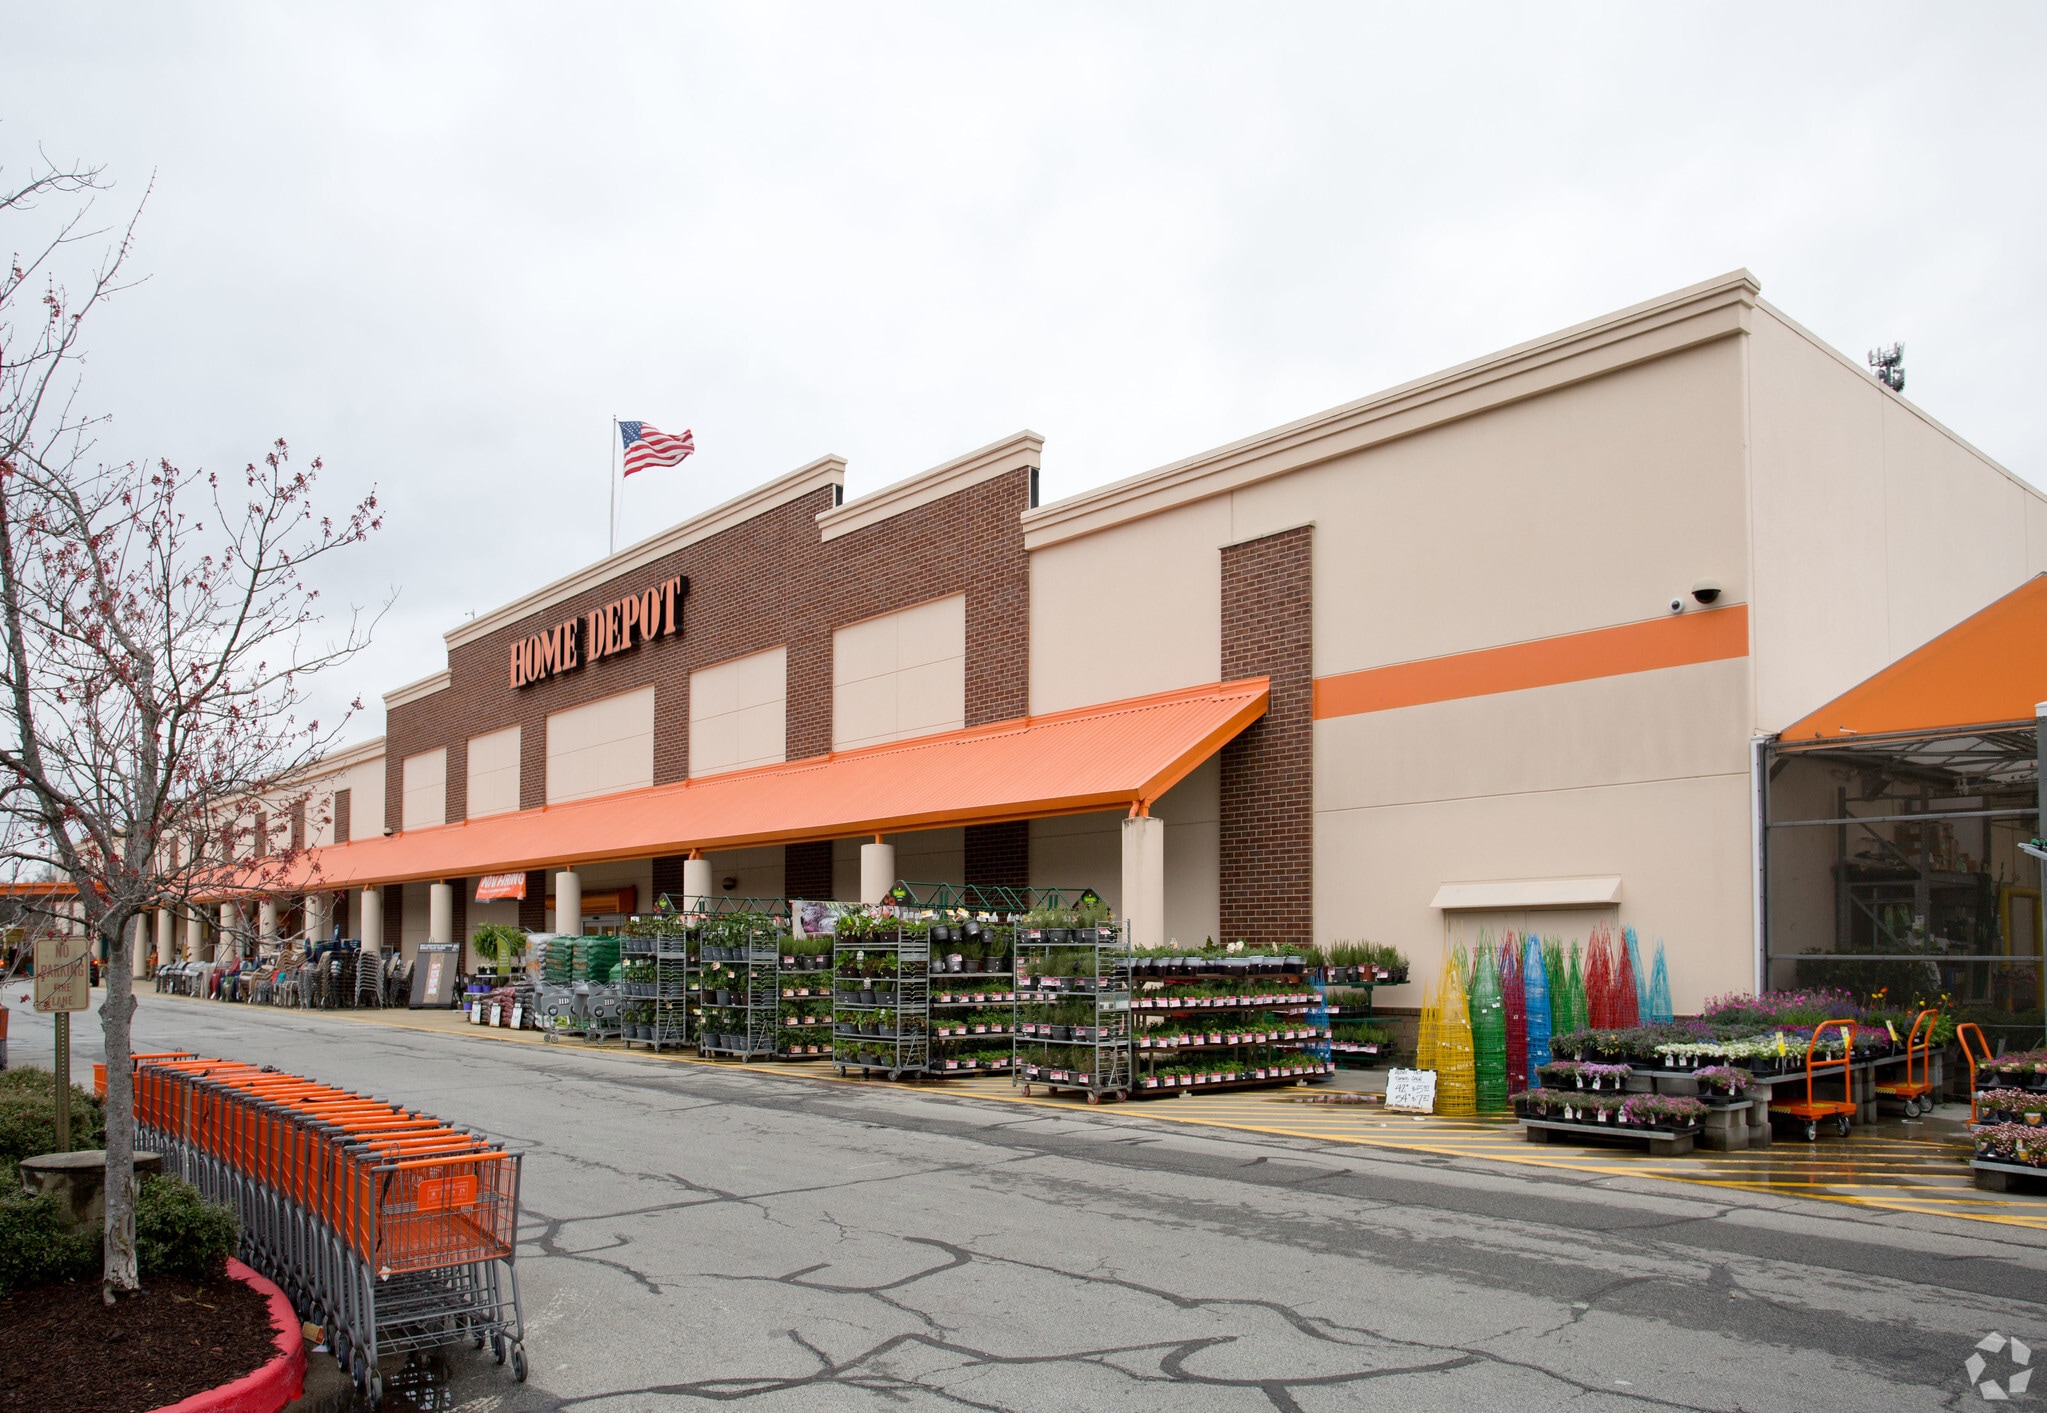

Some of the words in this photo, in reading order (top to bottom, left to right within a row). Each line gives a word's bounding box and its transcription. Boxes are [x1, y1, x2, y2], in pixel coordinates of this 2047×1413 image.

[509, 616, 580, 689] HOME
[587, 574, 684, 662] DEPOT
[55, 944, 70, 958] NO
[41, 964, 84, 977] PARKING
[51, 995, 73, 1006] LANE
